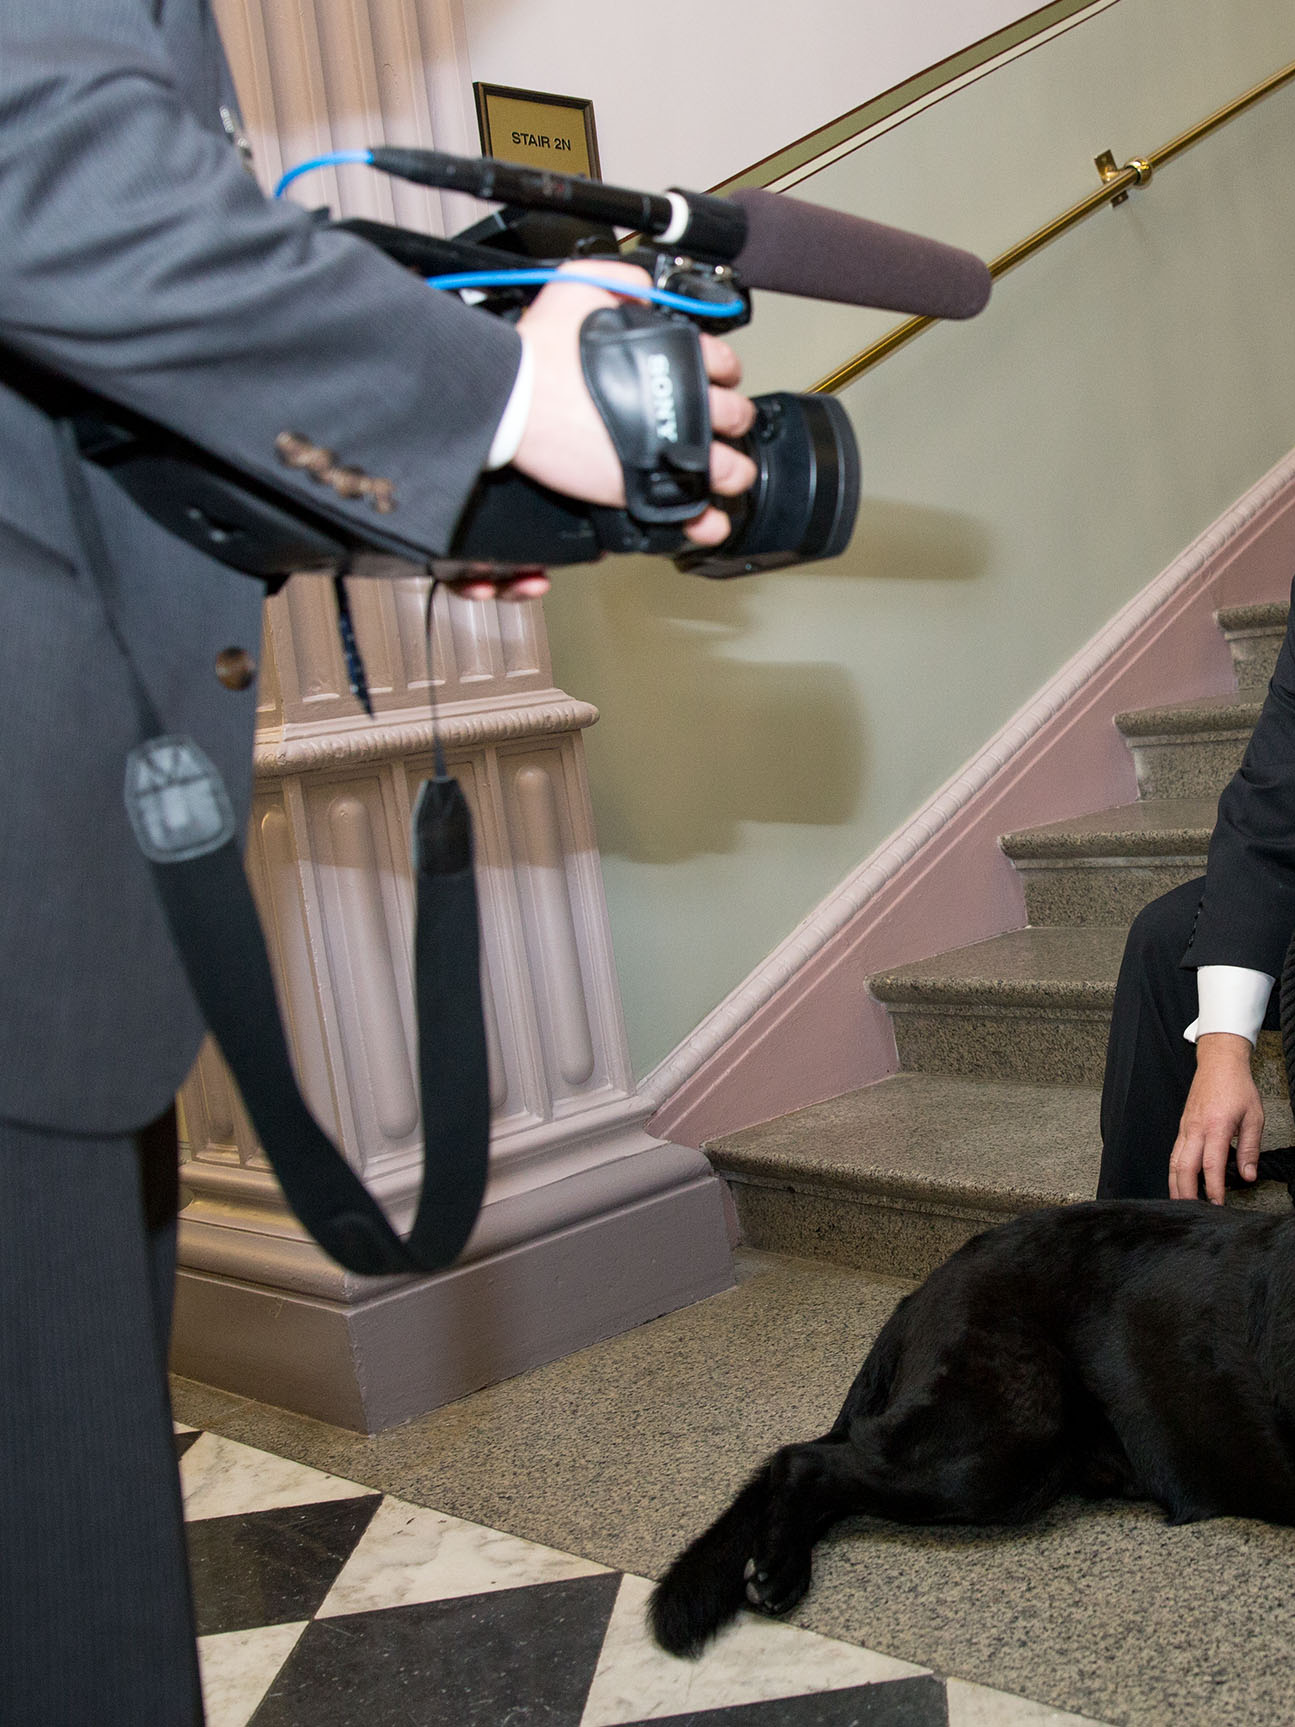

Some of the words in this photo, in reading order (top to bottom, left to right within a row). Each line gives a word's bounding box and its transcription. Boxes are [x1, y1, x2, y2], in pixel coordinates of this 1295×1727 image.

[512, 131, 550, 149] STAIR
[553, 138, 571, 151] 2N
[648, 353, 678, 443] SONY
